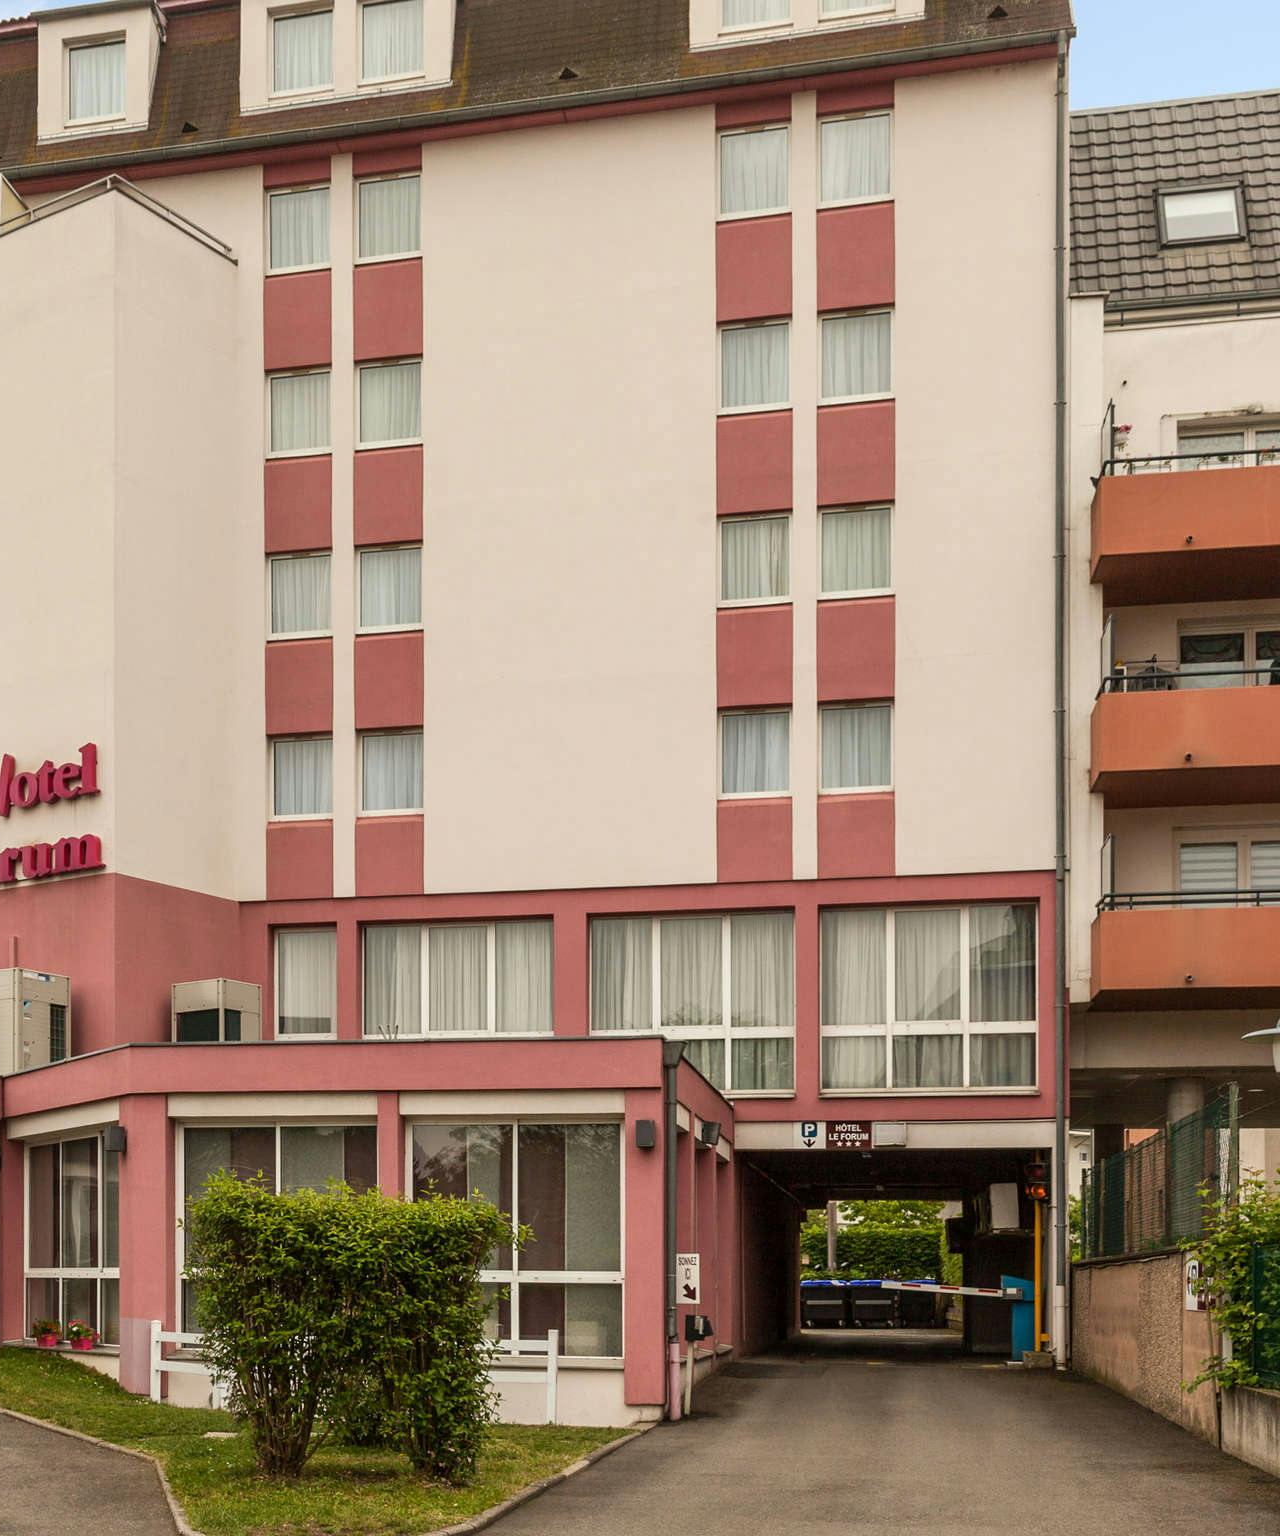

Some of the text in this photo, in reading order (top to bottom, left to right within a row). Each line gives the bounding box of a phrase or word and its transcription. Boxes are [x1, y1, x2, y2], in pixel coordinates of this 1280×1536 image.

[804, 1123, 816, 1137] P
[835, 1123, 862, 1132] HÔTEL
[840, 1133, 869, 1141] FORUM
